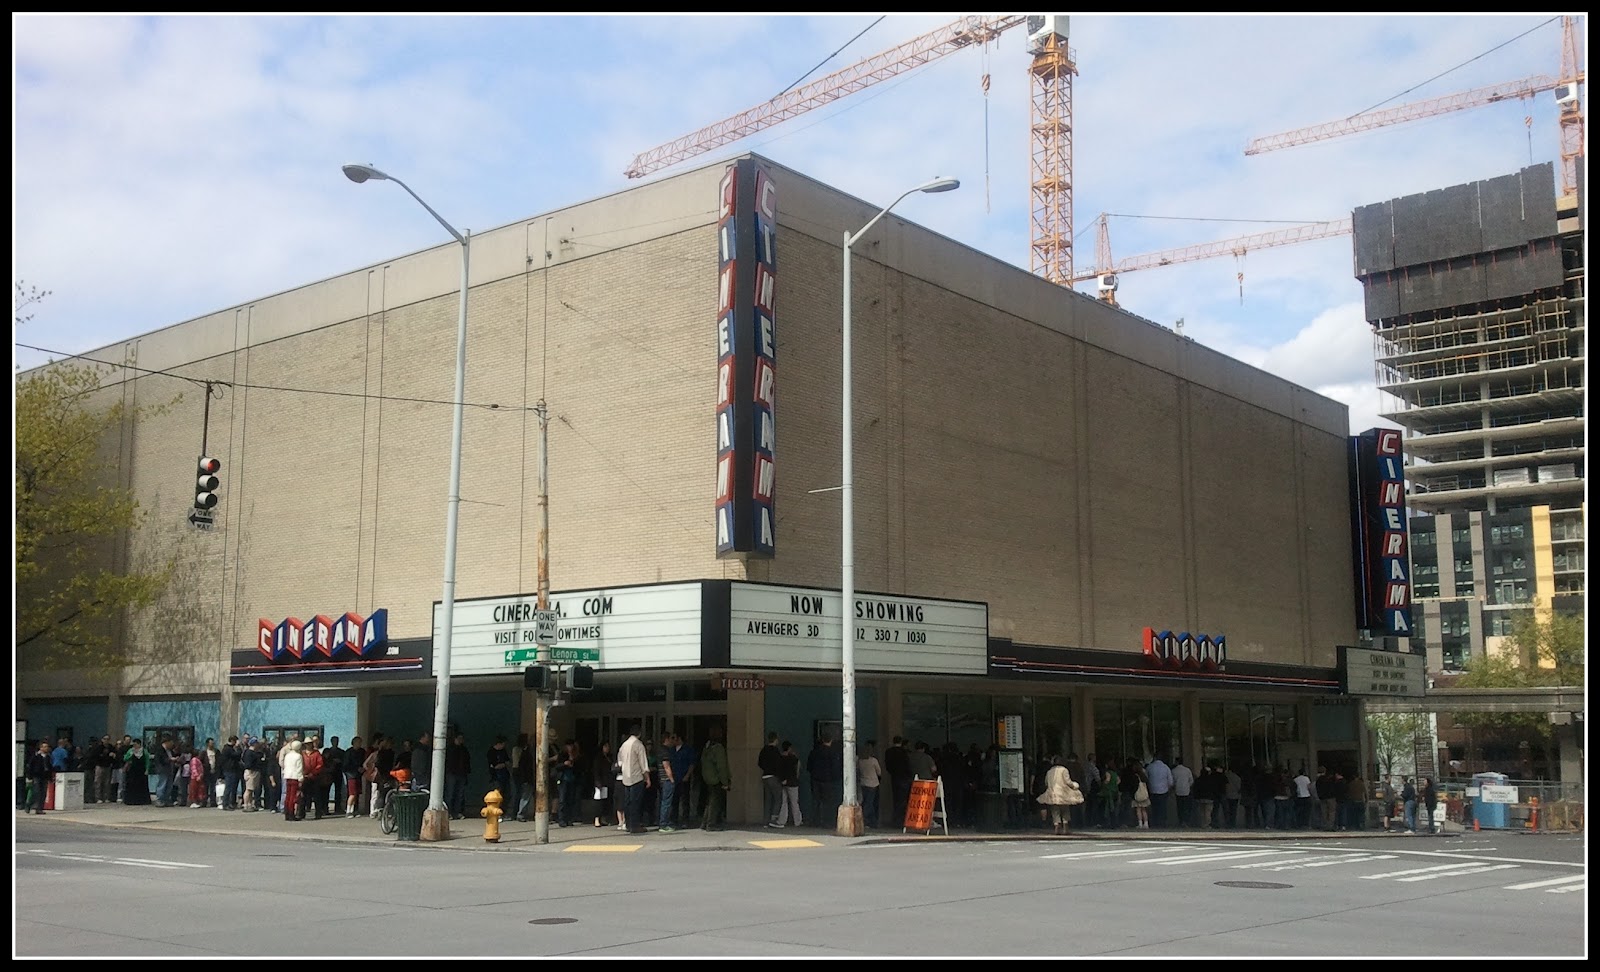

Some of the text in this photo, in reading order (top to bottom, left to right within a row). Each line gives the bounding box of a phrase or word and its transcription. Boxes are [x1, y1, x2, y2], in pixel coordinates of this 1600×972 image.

[718, 172, 732, 547] CINERAMA
[759, 180, 775, 547] CINERAMA
[1382, 433, 1408, 632] CINERAMA
[539, 612, 555, 621] ONE
[583, 597, 613, 616] COM
[790, 595, 924, 622] NOW SHOWING
[261, 618, 375, 653] CINERAMA
[494, 625, 601, 644] VISIT FO OWTIMES
[539, 622, 555, 631] WAY
[747, 621, 926, 644] AVENGERS 3D 12 330 7 1030
[551, 648, 578, 659] Lenora
[1152, 636, 1225, 664] CINERAMA
[722, 678, 760, 690] TICKETS
